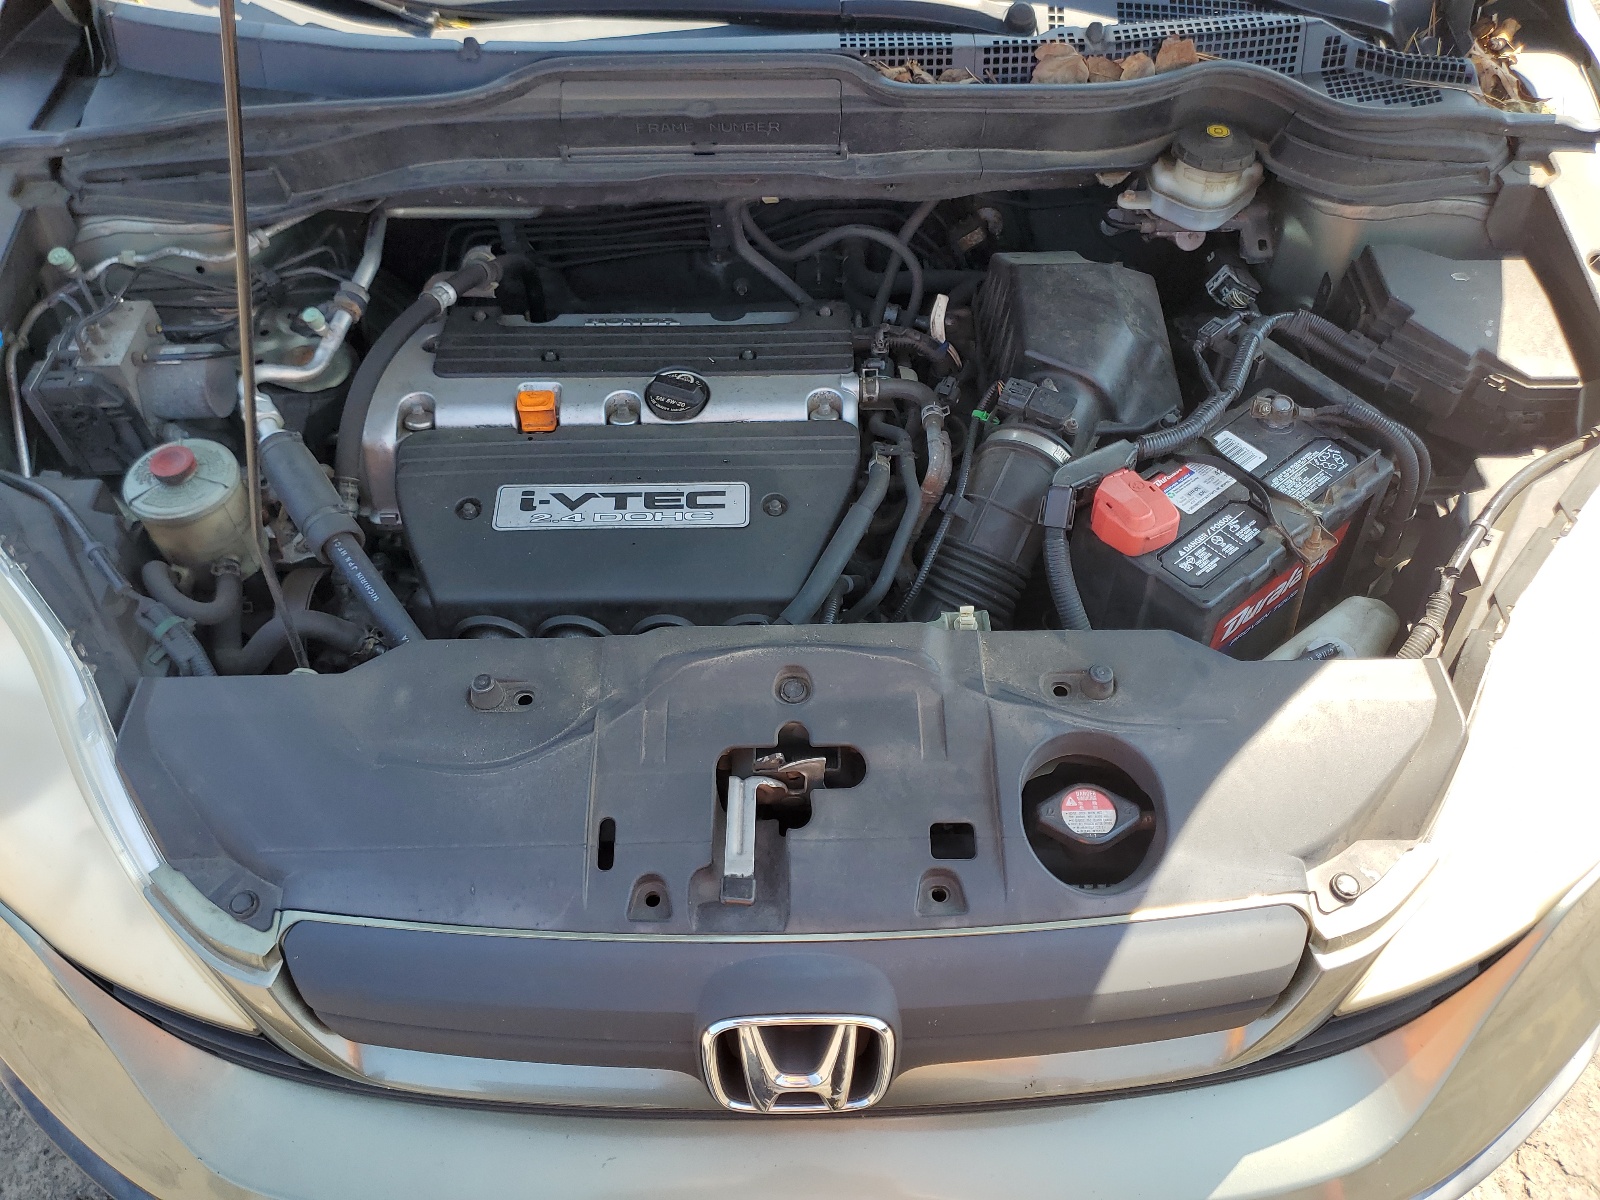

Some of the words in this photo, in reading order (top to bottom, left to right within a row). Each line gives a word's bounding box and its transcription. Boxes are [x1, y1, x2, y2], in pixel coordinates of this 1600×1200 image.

[636, 123, 694, 134] FRAME
[709, 122, 780, 134] NUMBER
[520, 490, 727, 512] i-VTEC
[530, 512, 586, 523] 2.4
[593, 511, 714, 523] DOHC
[1182, 532, 1208, 552] DANGER
[1210, 513, 1232, 531] POISON
